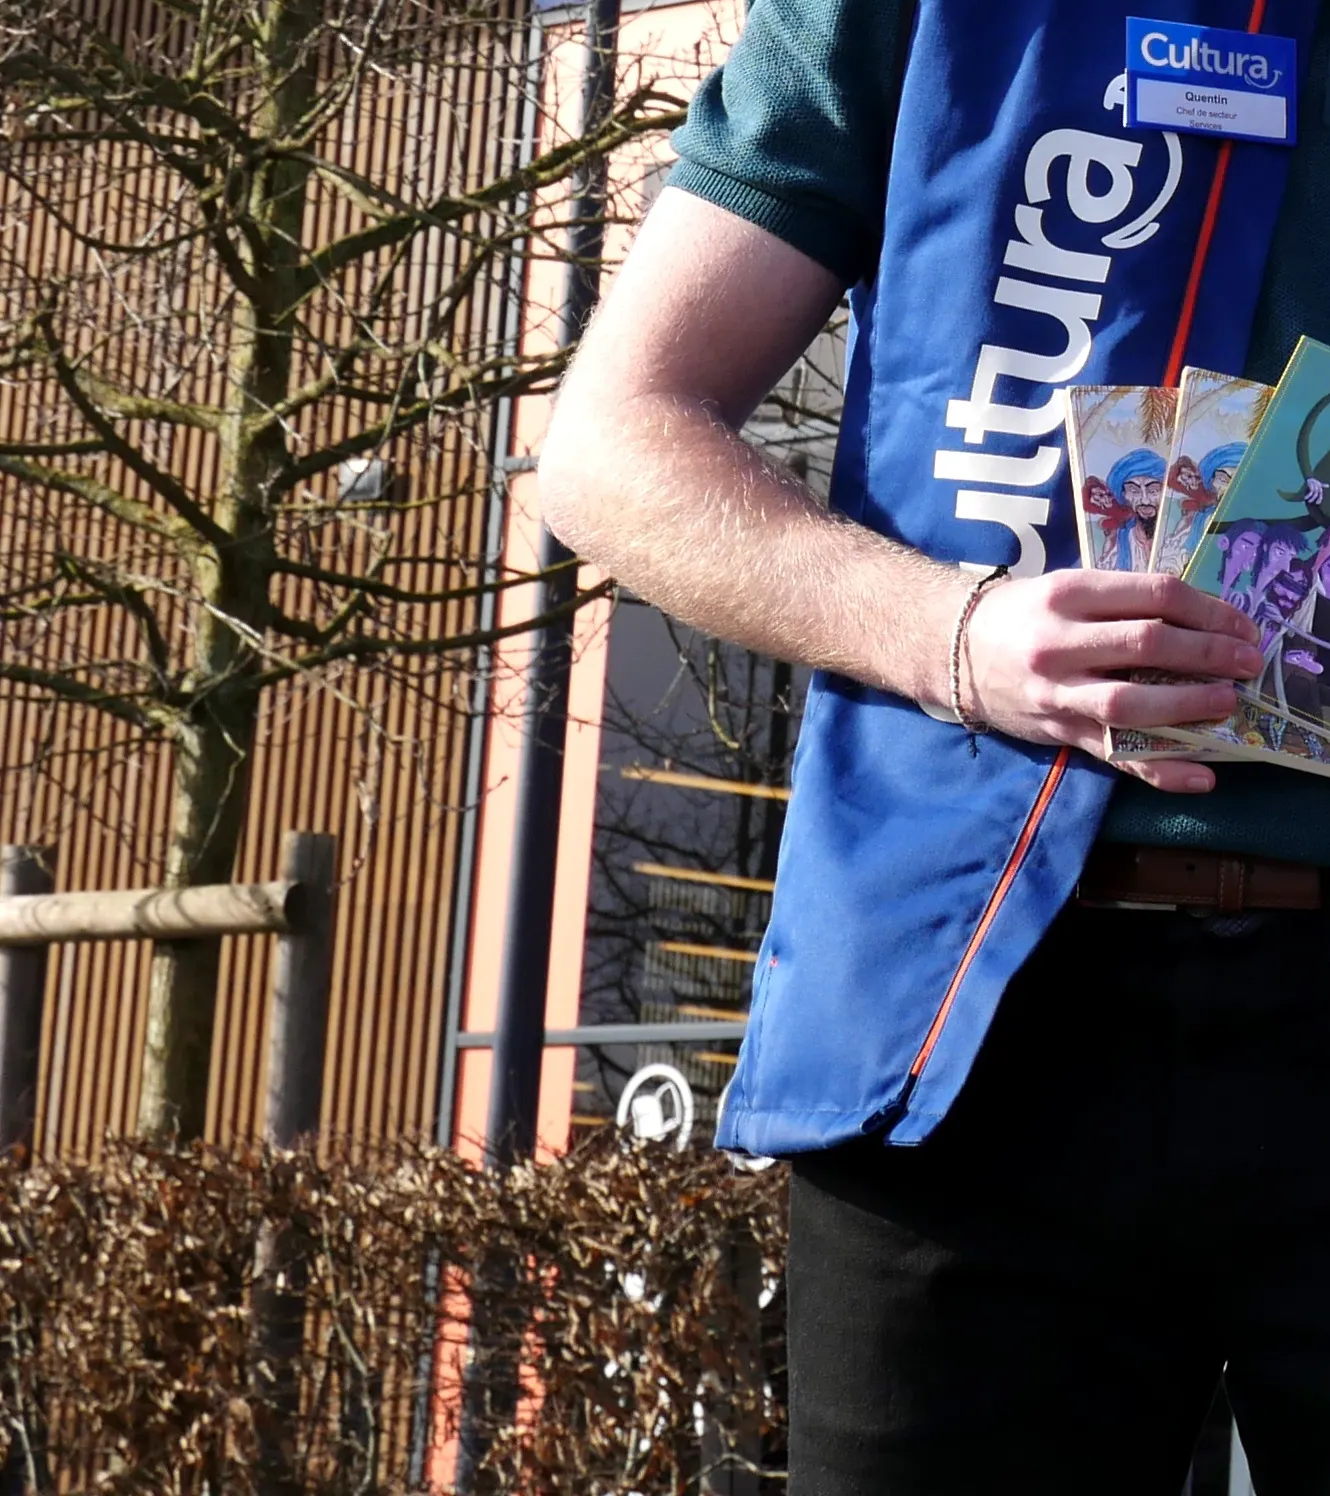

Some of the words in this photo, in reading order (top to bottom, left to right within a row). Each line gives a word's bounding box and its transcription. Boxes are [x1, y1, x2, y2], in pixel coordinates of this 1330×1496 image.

[1141, 32, 1268, 80] Cultura
[1176, 107, 1195, 117] Chef
[1196, 108, 1207, 117] de
[1209, 109, 1237, 120] secteur
[1185, 91, 1228, 106] Quentin
[932, 126, 1143, 582] ultura
